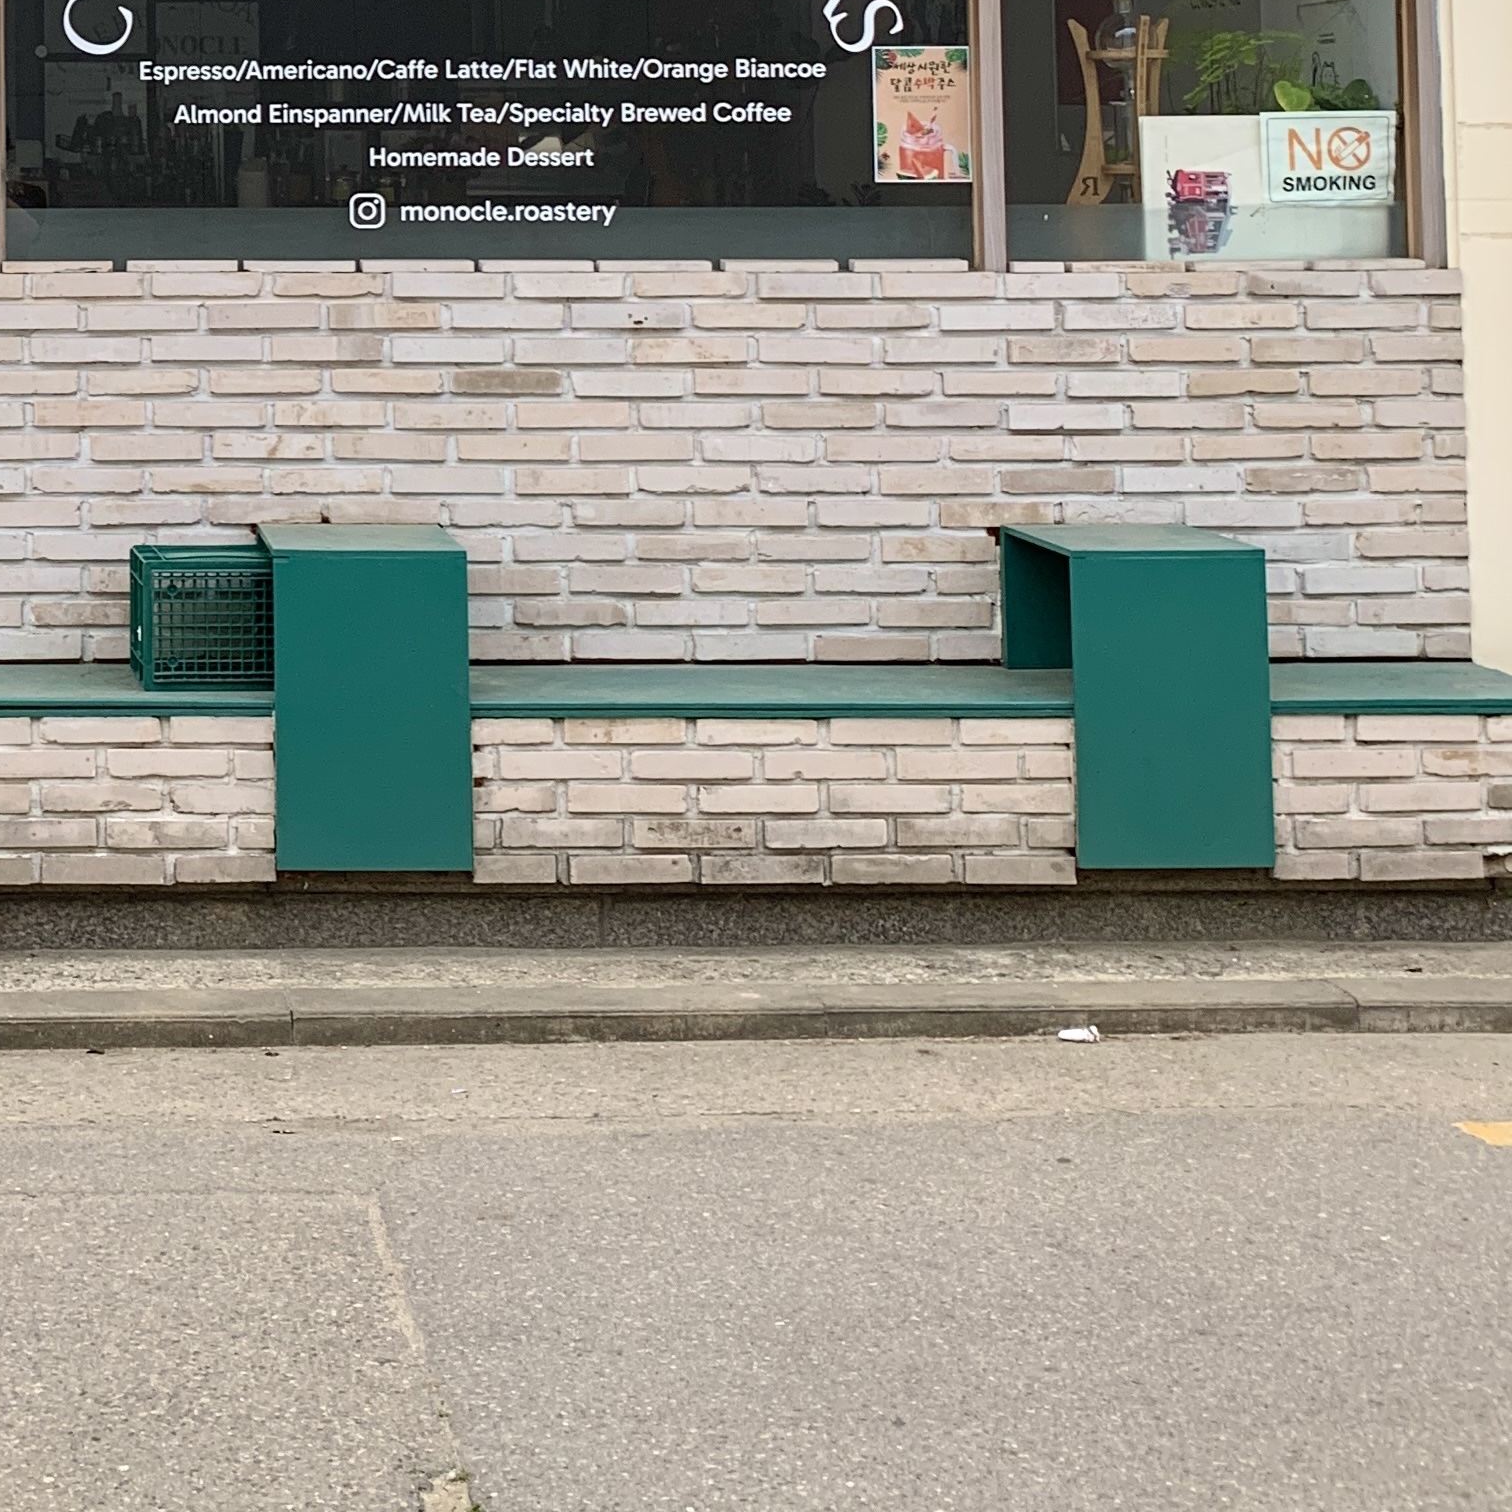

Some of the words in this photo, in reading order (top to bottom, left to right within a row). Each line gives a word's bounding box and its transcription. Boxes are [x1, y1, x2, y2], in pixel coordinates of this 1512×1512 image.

[139, 58, 439, 85] Espresso/Americano/Caffe
[445, 58, 557, 81] Latte/Flat
[562, 57, 729, 84] White/Orange
[735, 57, 828, 79] Biancoe
[173, 103, 262, 125] Almond
[269, 102, 452, 129] Einspanner/Milk
[456, 102, 614, 128] Tea/Specialty
[621, 102, 707, 124] Brewed
[713, 102, 792, 124] Coffee
[369, 146, 501, 168] Homemade
[507, 147, 595, 168] Dessert
[1287, 125, 1371, 172] NO
[1282, 174, 1377, 192] SMOKING
[400, 199, 617, 227] monocle.roastery
